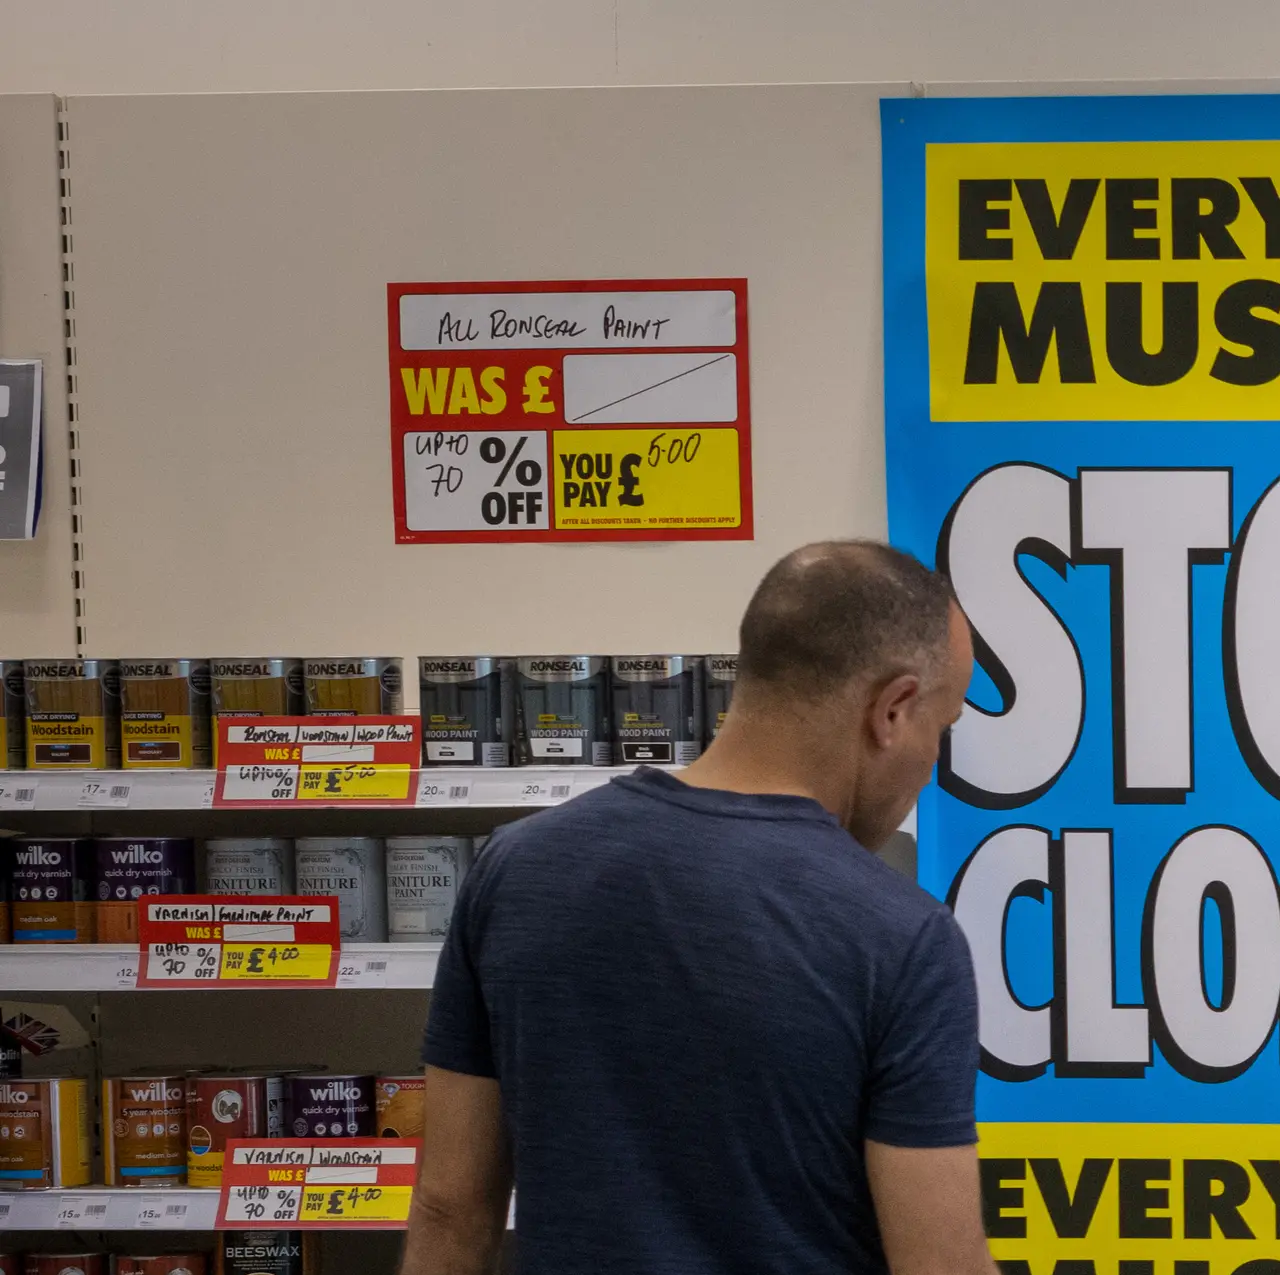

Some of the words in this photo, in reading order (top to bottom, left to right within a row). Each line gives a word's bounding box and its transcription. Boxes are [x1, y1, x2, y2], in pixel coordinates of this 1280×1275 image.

[438, 312, 479, 344] ALL
[490, 310, 587, 339] RONSEAL
[604, 305, 670, 339] PAINT
[401, 366, 507, 415] WAS
[522, 366, 555, 414] £
[560, 453, 612, 480] YOU
[563, 481, 611, 508] PAY
[481, 491, 542, 526] OFF
[308, 663, 365, 676] RONSEAL
[530, 661, 585, 672] RONSEAL
[32, 723, 93, 736] Woodstain
[111, 845, 163, 864] wilko
[125, 869, 140, 878] dry
[269, 1170, 292, 1180] WAS
[225, 1246, 300, 1258] BEESWAX
